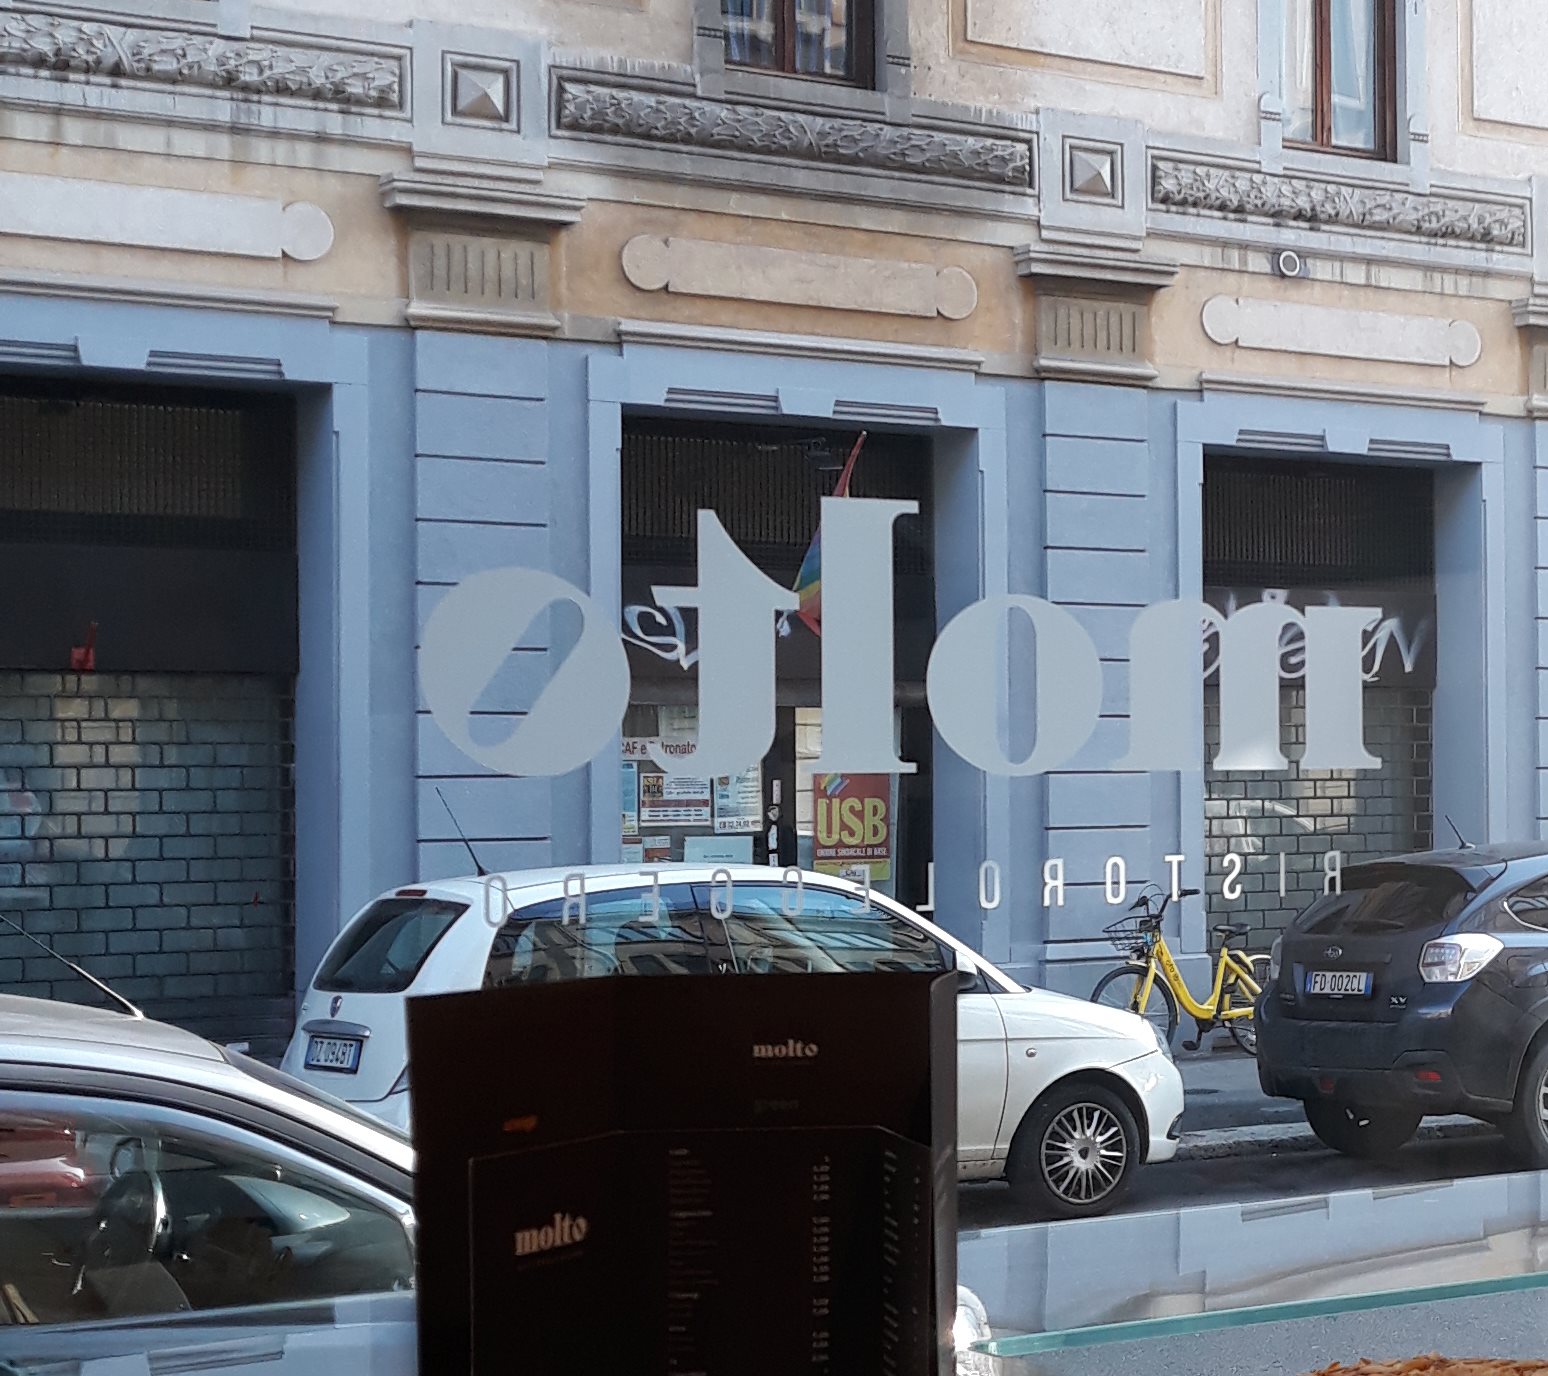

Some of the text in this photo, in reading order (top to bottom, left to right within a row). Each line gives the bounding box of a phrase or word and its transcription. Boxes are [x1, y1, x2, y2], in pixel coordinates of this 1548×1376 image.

[816, 796, 888, 846] USB
[752, 1038, 819, 1058] molto
[513, 1211, 588, 1257] molto
